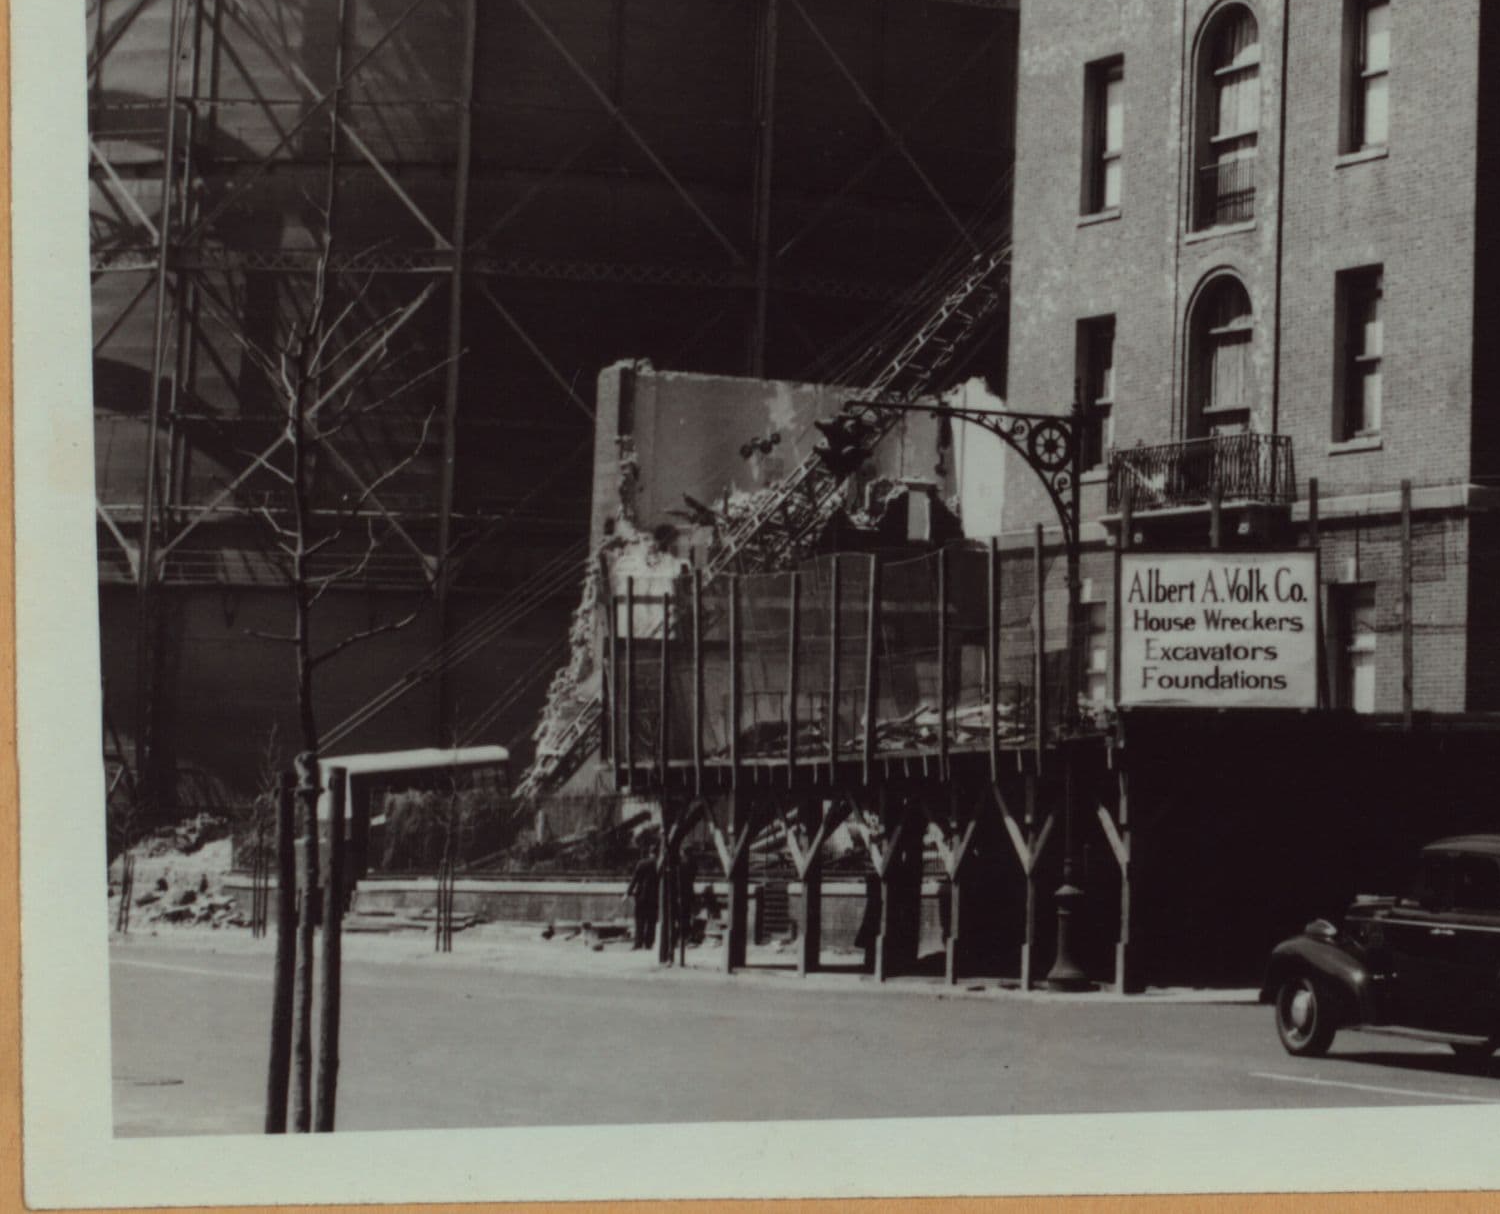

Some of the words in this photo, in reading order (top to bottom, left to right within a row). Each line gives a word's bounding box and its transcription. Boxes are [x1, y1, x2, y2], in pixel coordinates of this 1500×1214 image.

[1127, 568, 1197, 604] Albert
[1274, 567, 1308, 604] Co.
[1133, 609, 1197, 633] House
[1202, 609, 1305, 633] Wreckers
[1144, 638, 1279, 662] Excavators
[1141, 665, 1288, 691] Foundations
